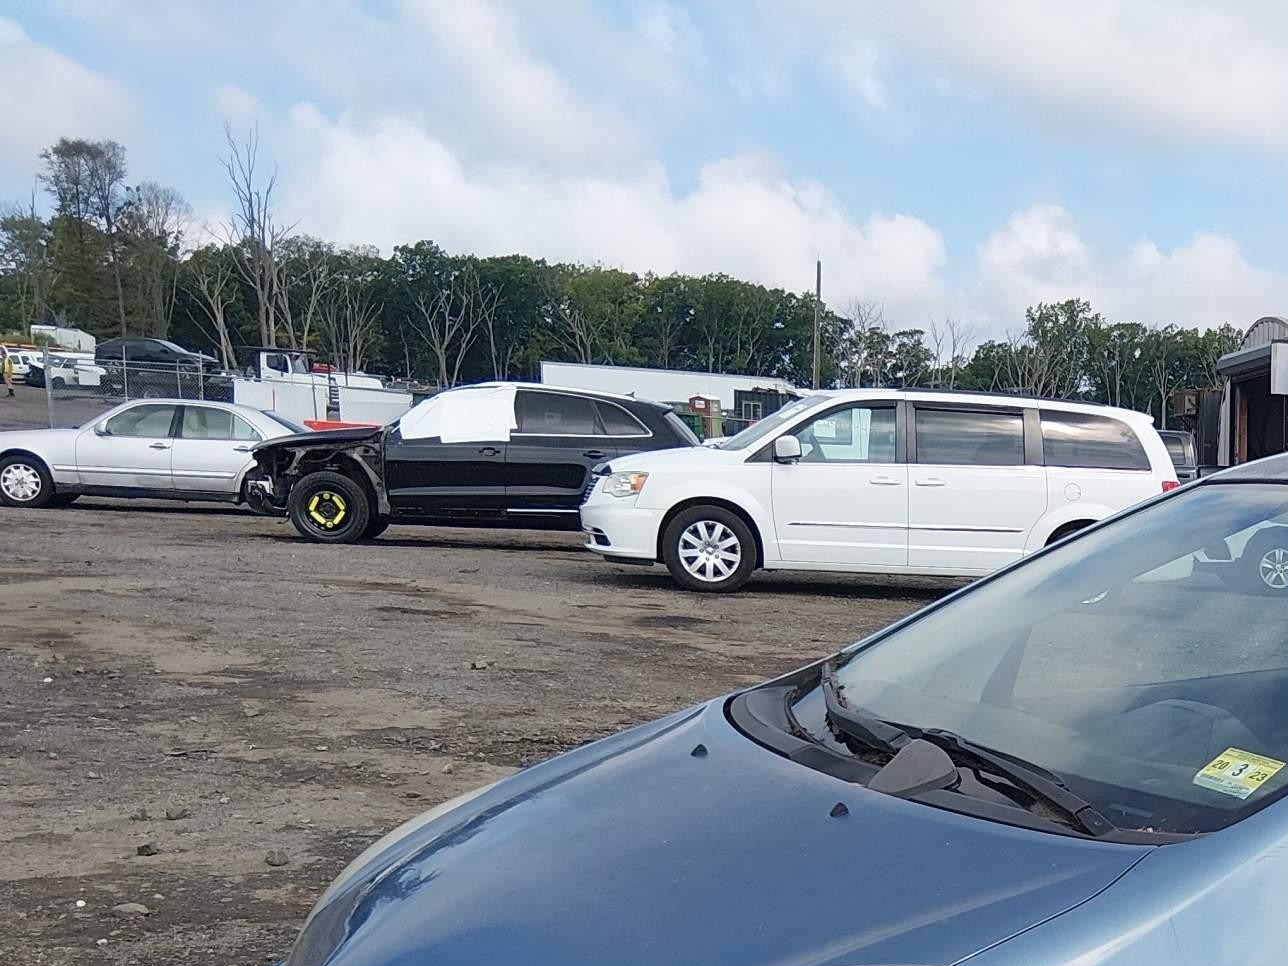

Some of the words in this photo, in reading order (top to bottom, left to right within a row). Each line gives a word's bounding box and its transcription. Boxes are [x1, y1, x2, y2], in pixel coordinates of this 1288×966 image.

[1211, 759, 1230, 770] 20
[1231, 763, 1250, 777] 3
[1248, 771, 1269, 782] 23
